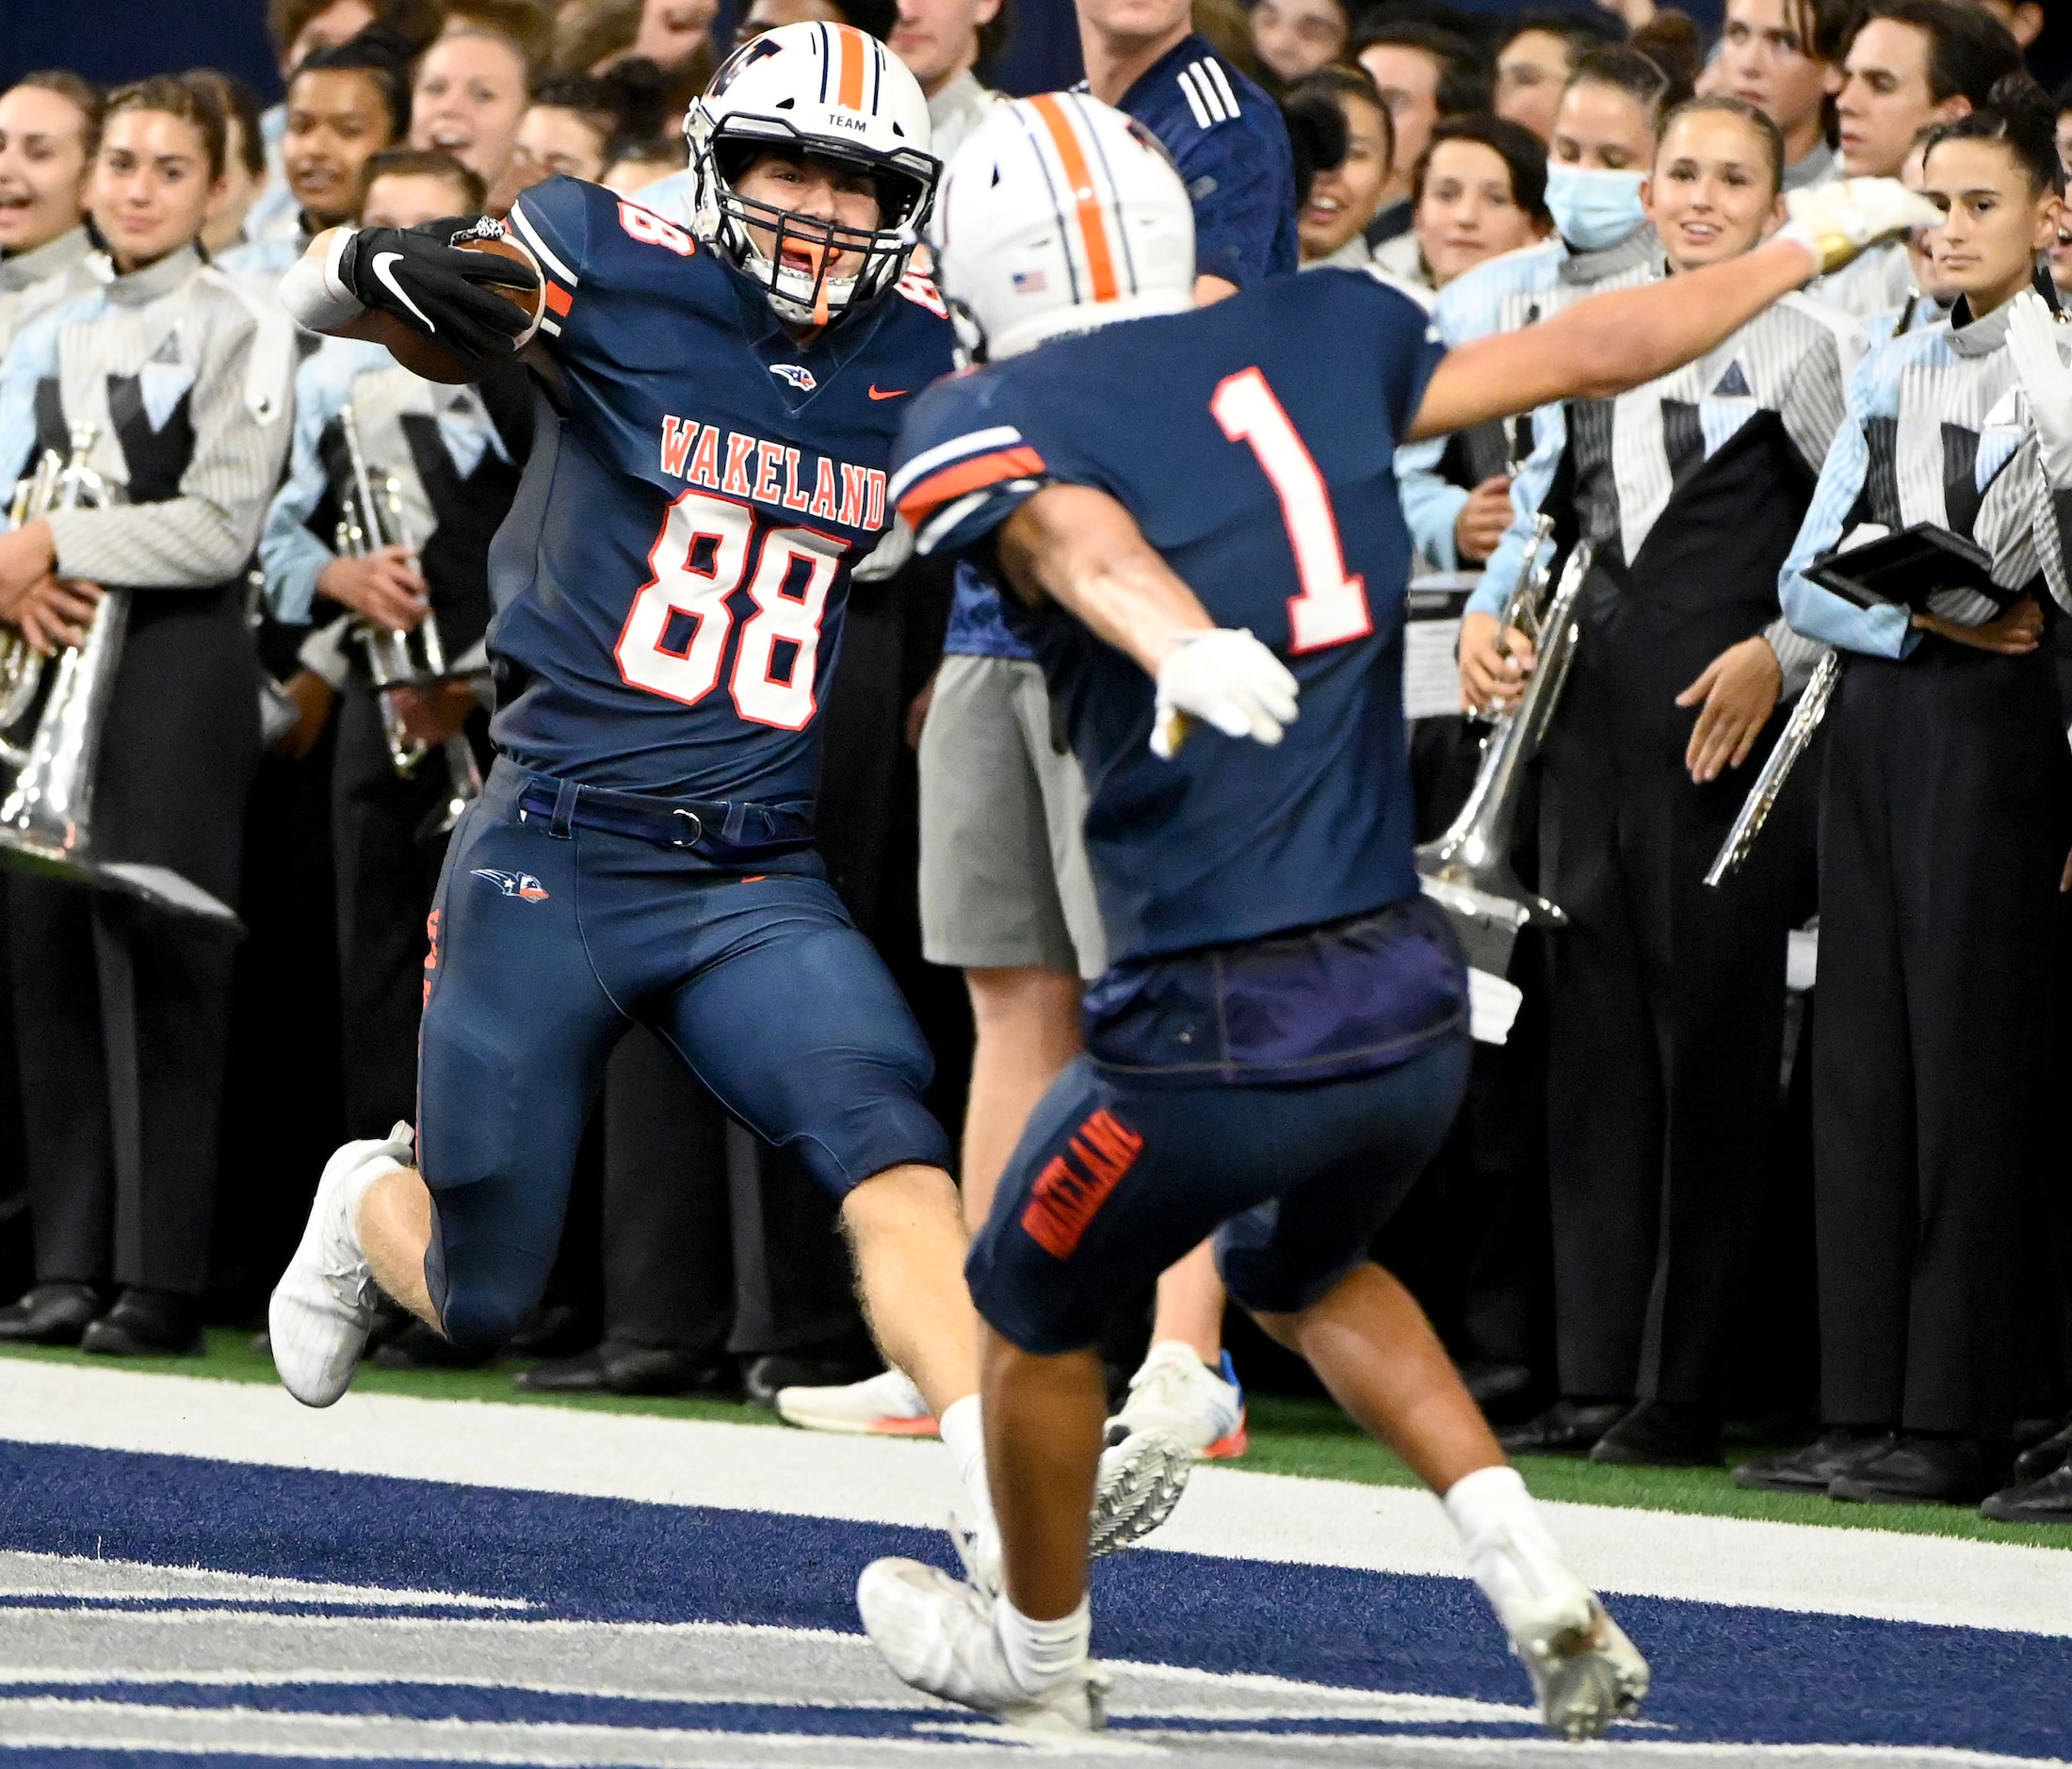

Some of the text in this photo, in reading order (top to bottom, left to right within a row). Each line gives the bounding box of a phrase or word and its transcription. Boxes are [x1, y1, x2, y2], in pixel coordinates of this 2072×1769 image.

[829, 113, 866, 133] TEAM
[661, 414, 887, 532] WAKELAND
[1209, 365, 1375, 655] 1
[613, 488, 852, 732] 88
